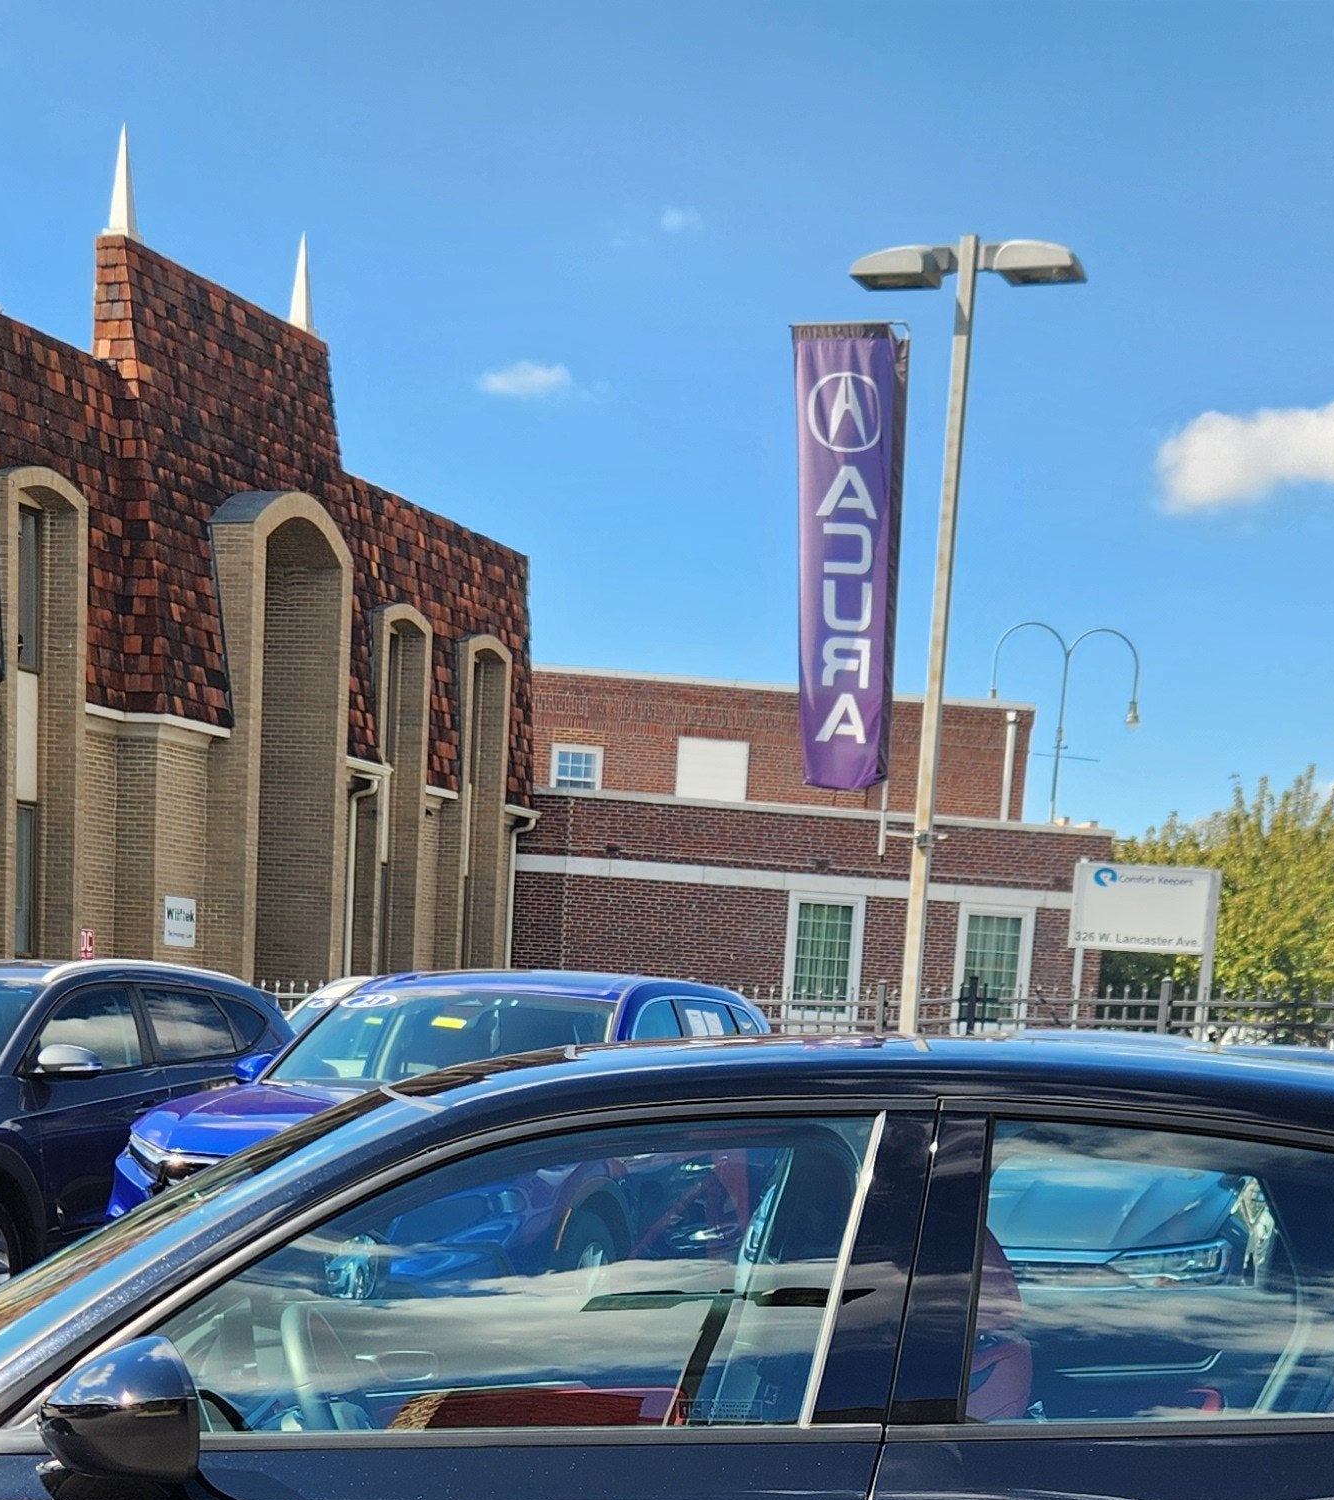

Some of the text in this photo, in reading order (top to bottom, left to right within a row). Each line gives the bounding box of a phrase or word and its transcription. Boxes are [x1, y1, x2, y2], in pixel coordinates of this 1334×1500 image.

[1119, 874, 1194, 887] Comfort Keepers
[1074, 931, 1095, 942] 326
[1116, 934, 1174, 946] Lancaster
